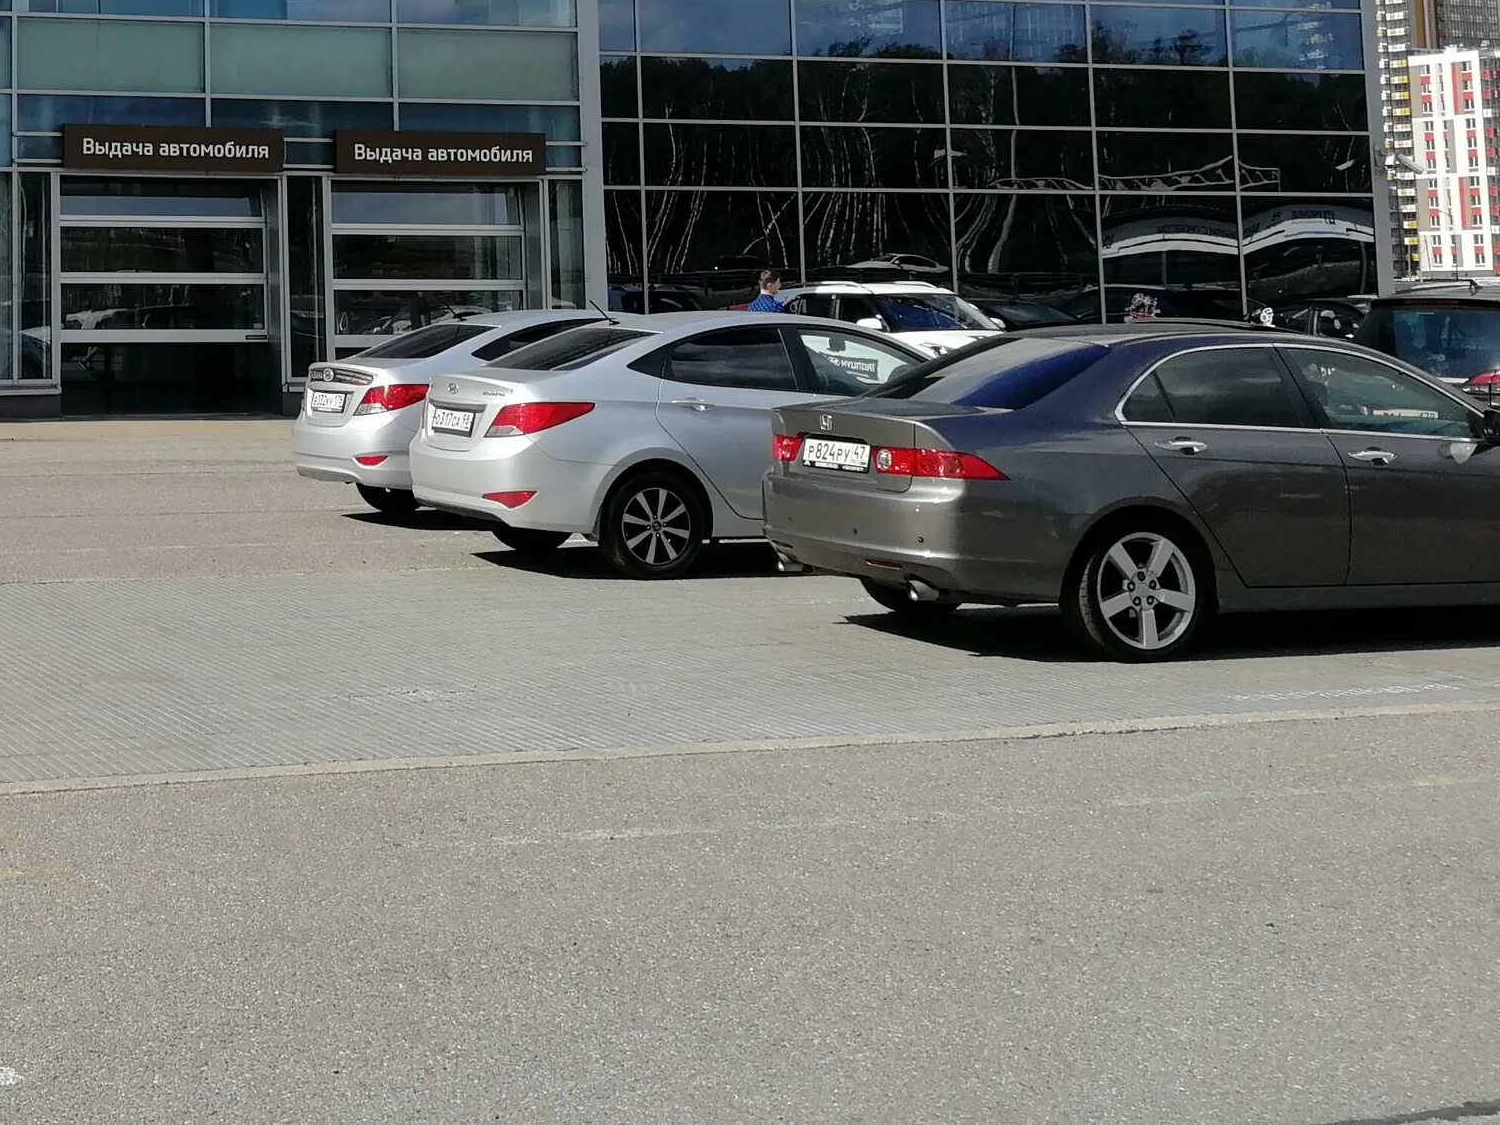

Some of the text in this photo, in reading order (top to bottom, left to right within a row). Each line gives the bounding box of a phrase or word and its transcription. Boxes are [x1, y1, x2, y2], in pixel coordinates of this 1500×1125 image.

[82, 138, 269, 159] Выдача автомобиля
[354, 143, 534, 163] Выдача автомобиля
